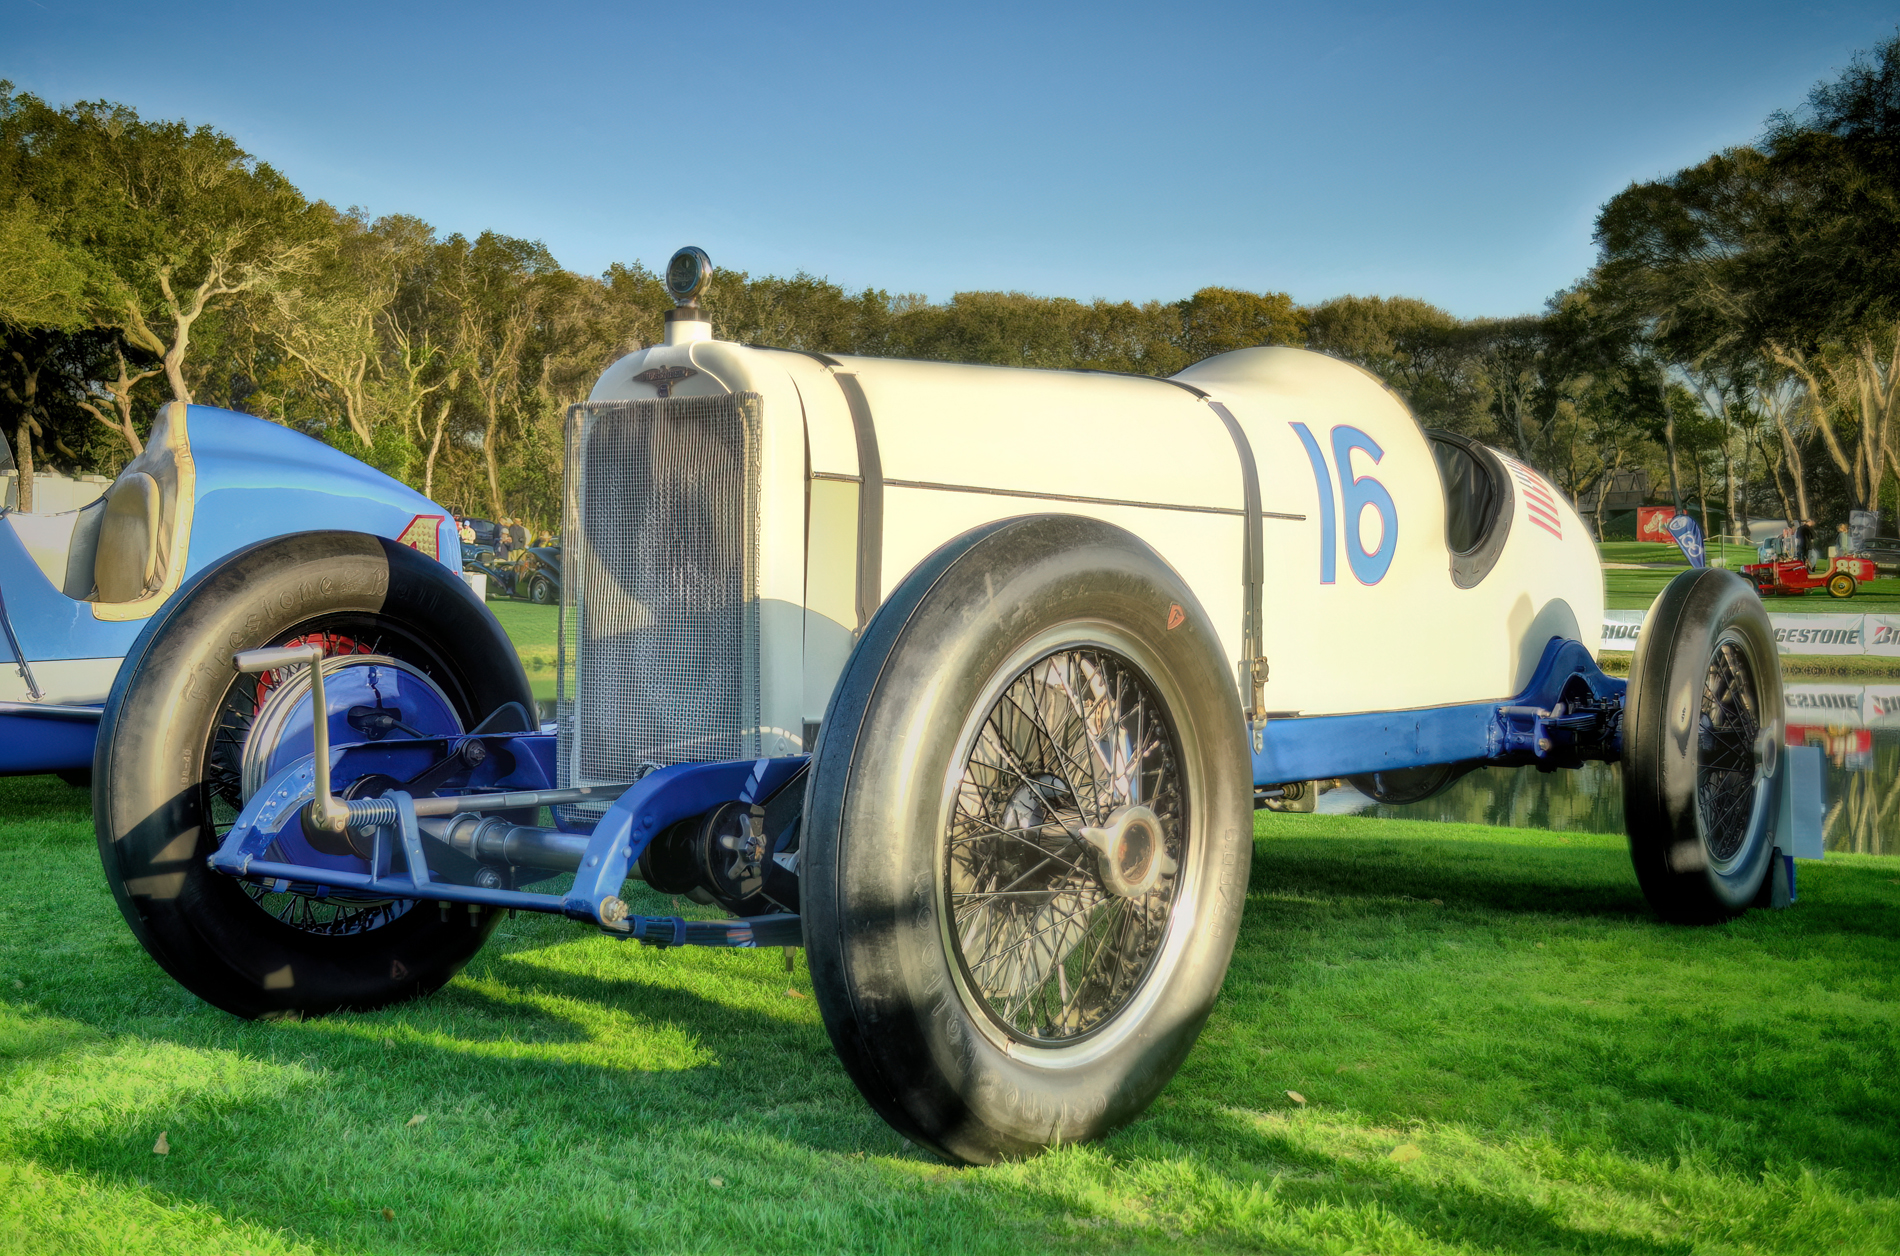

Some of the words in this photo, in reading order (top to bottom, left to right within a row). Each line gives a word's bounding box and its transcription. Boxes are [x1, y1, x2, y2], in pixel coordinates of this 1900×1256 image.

[1288, 421, 1398, 586] 16
[1836, 559, 1860, 576] 88
[183, 576, 333, 703] Firestone
